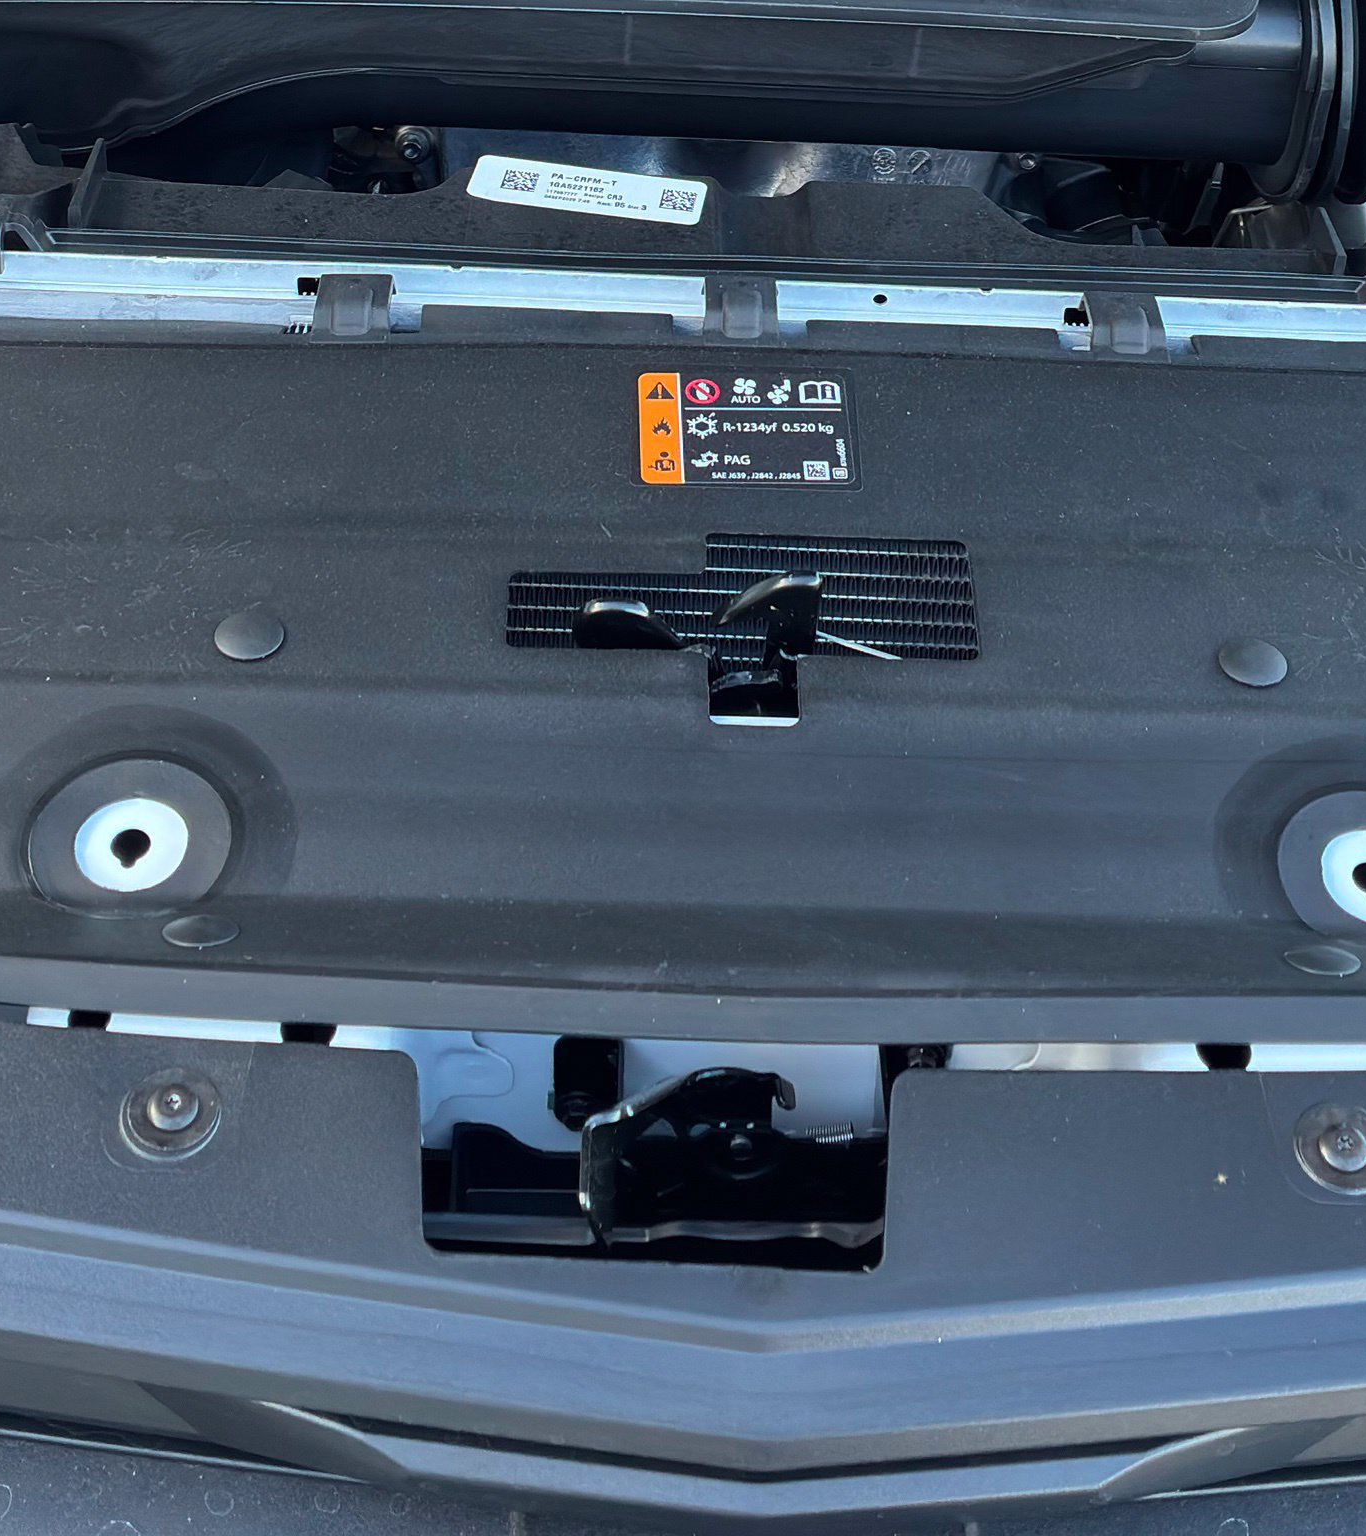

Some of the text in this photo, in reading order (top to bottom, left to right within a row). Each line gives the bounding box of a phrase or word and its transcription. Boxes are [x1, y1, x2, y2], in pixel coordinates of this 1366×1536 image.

[731, 395, 761, 404] AUTO
[723, 422, 834, 435] R-1234yf 0.520 kg
[724, 454, 751, 465] PAG
[711, 471, 727, 479] SAE
